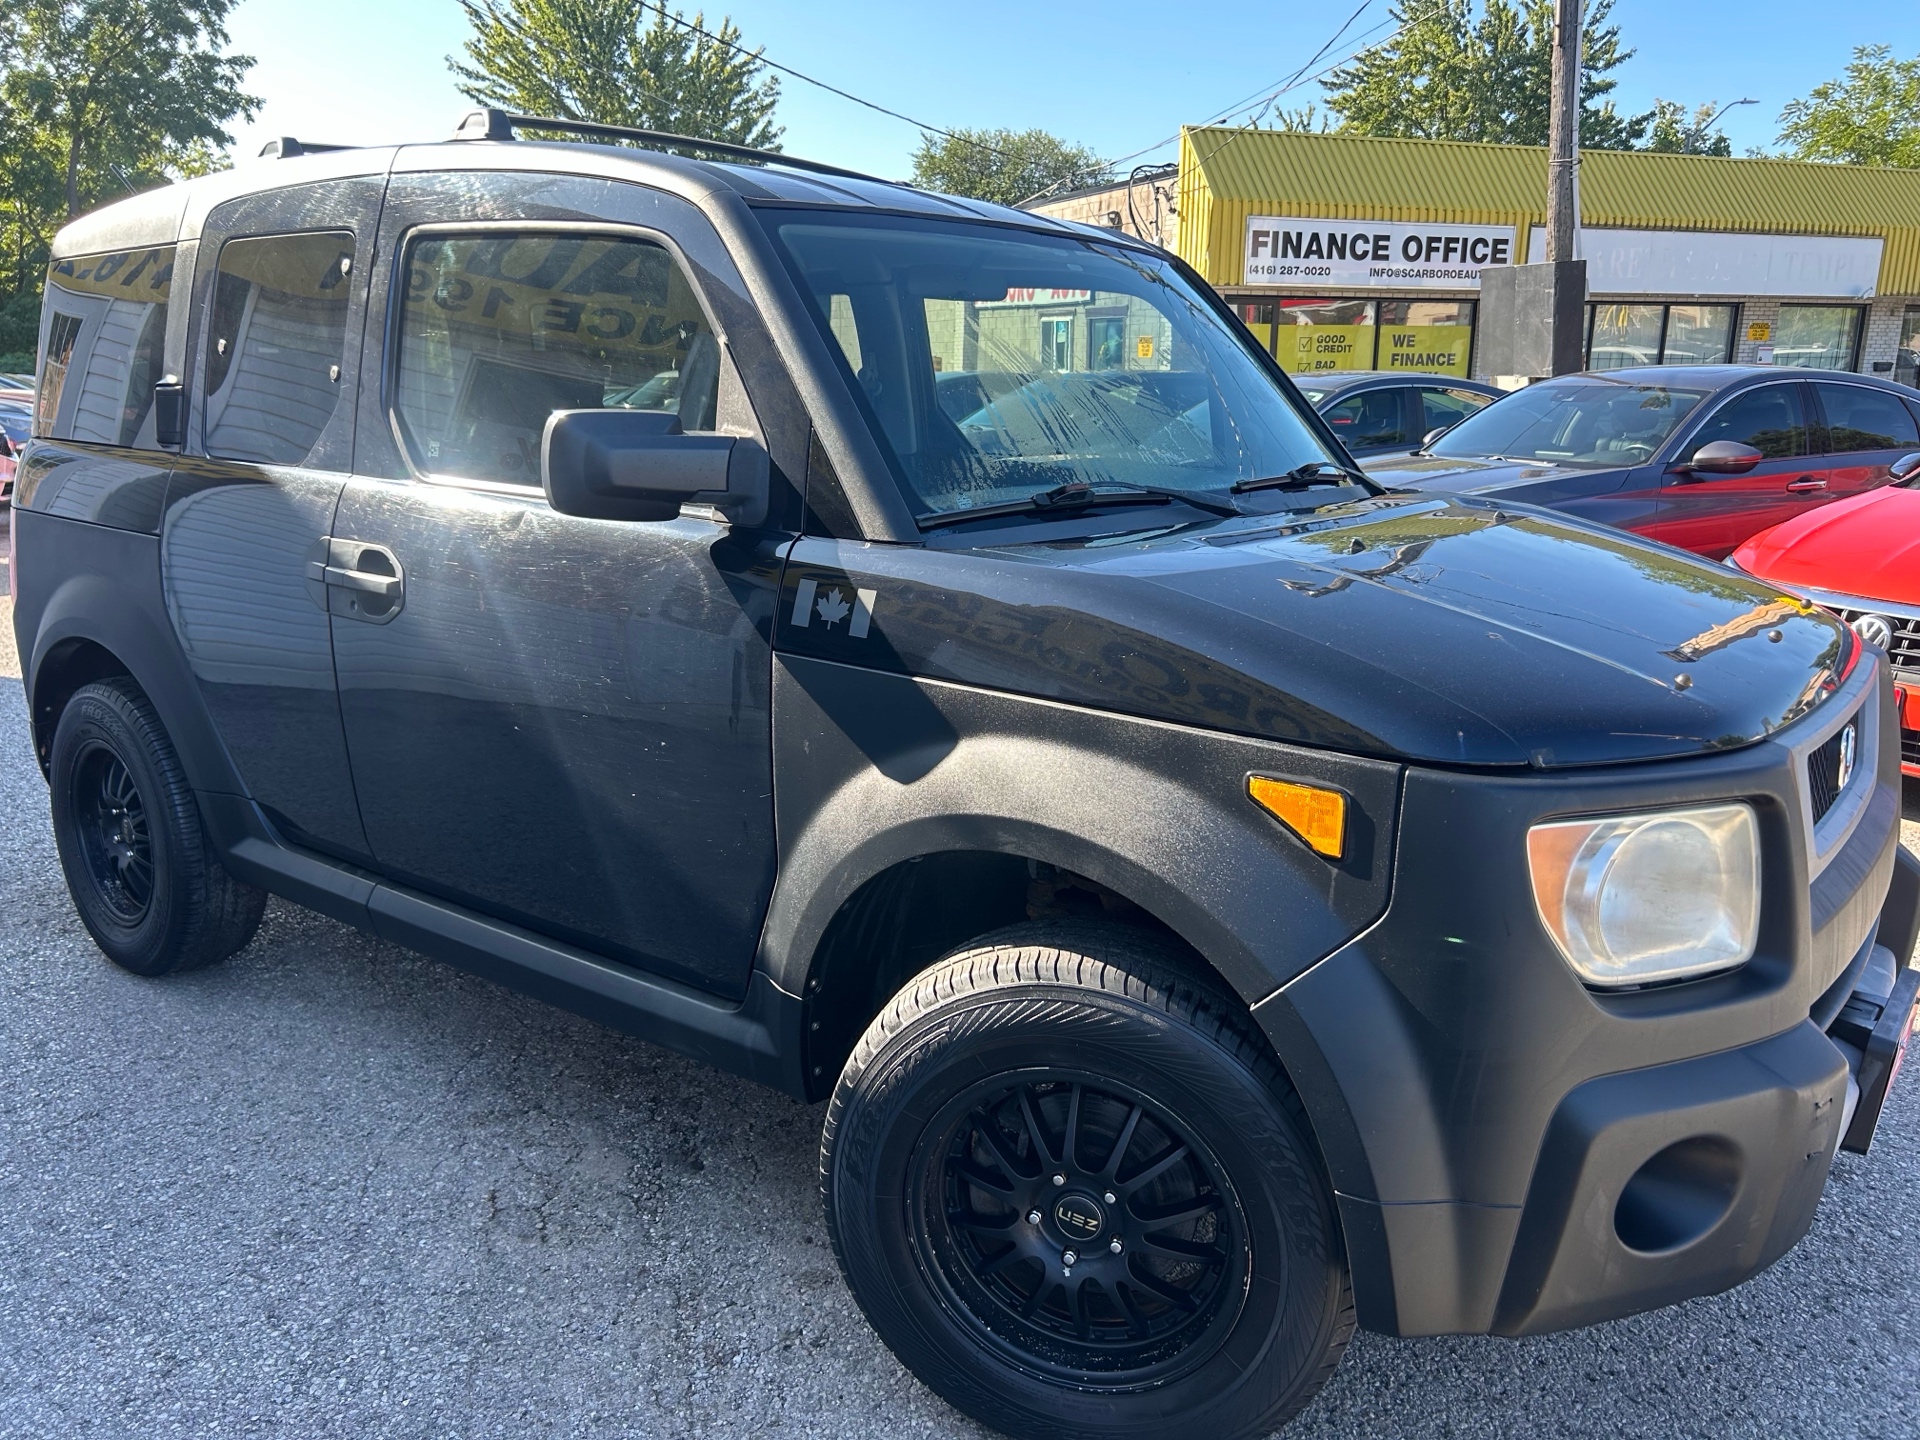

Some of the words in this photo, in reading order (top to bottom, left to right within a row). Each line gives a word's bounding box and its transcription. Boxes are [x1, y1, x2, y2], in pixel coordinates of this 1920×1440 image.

[1250, 230, 1391, 261] FINANCE
[1401, 234, 1510, 264] OFFICE
[1249, 264, 1276, 275] (416)
[1279, 265, 1331, 276] 287-0020
[1369, 267, 1482, 280] INFO@SCARBOROEAUT
[1317, 334, 1346, 344] GOOD
[1392, 334, 1416, 348] WE
[1316, 344, 1353, 353] CREDIT
[1314, 361, 1336, 370] BAD
[1390, 353, 1456, 367] FINANCE
